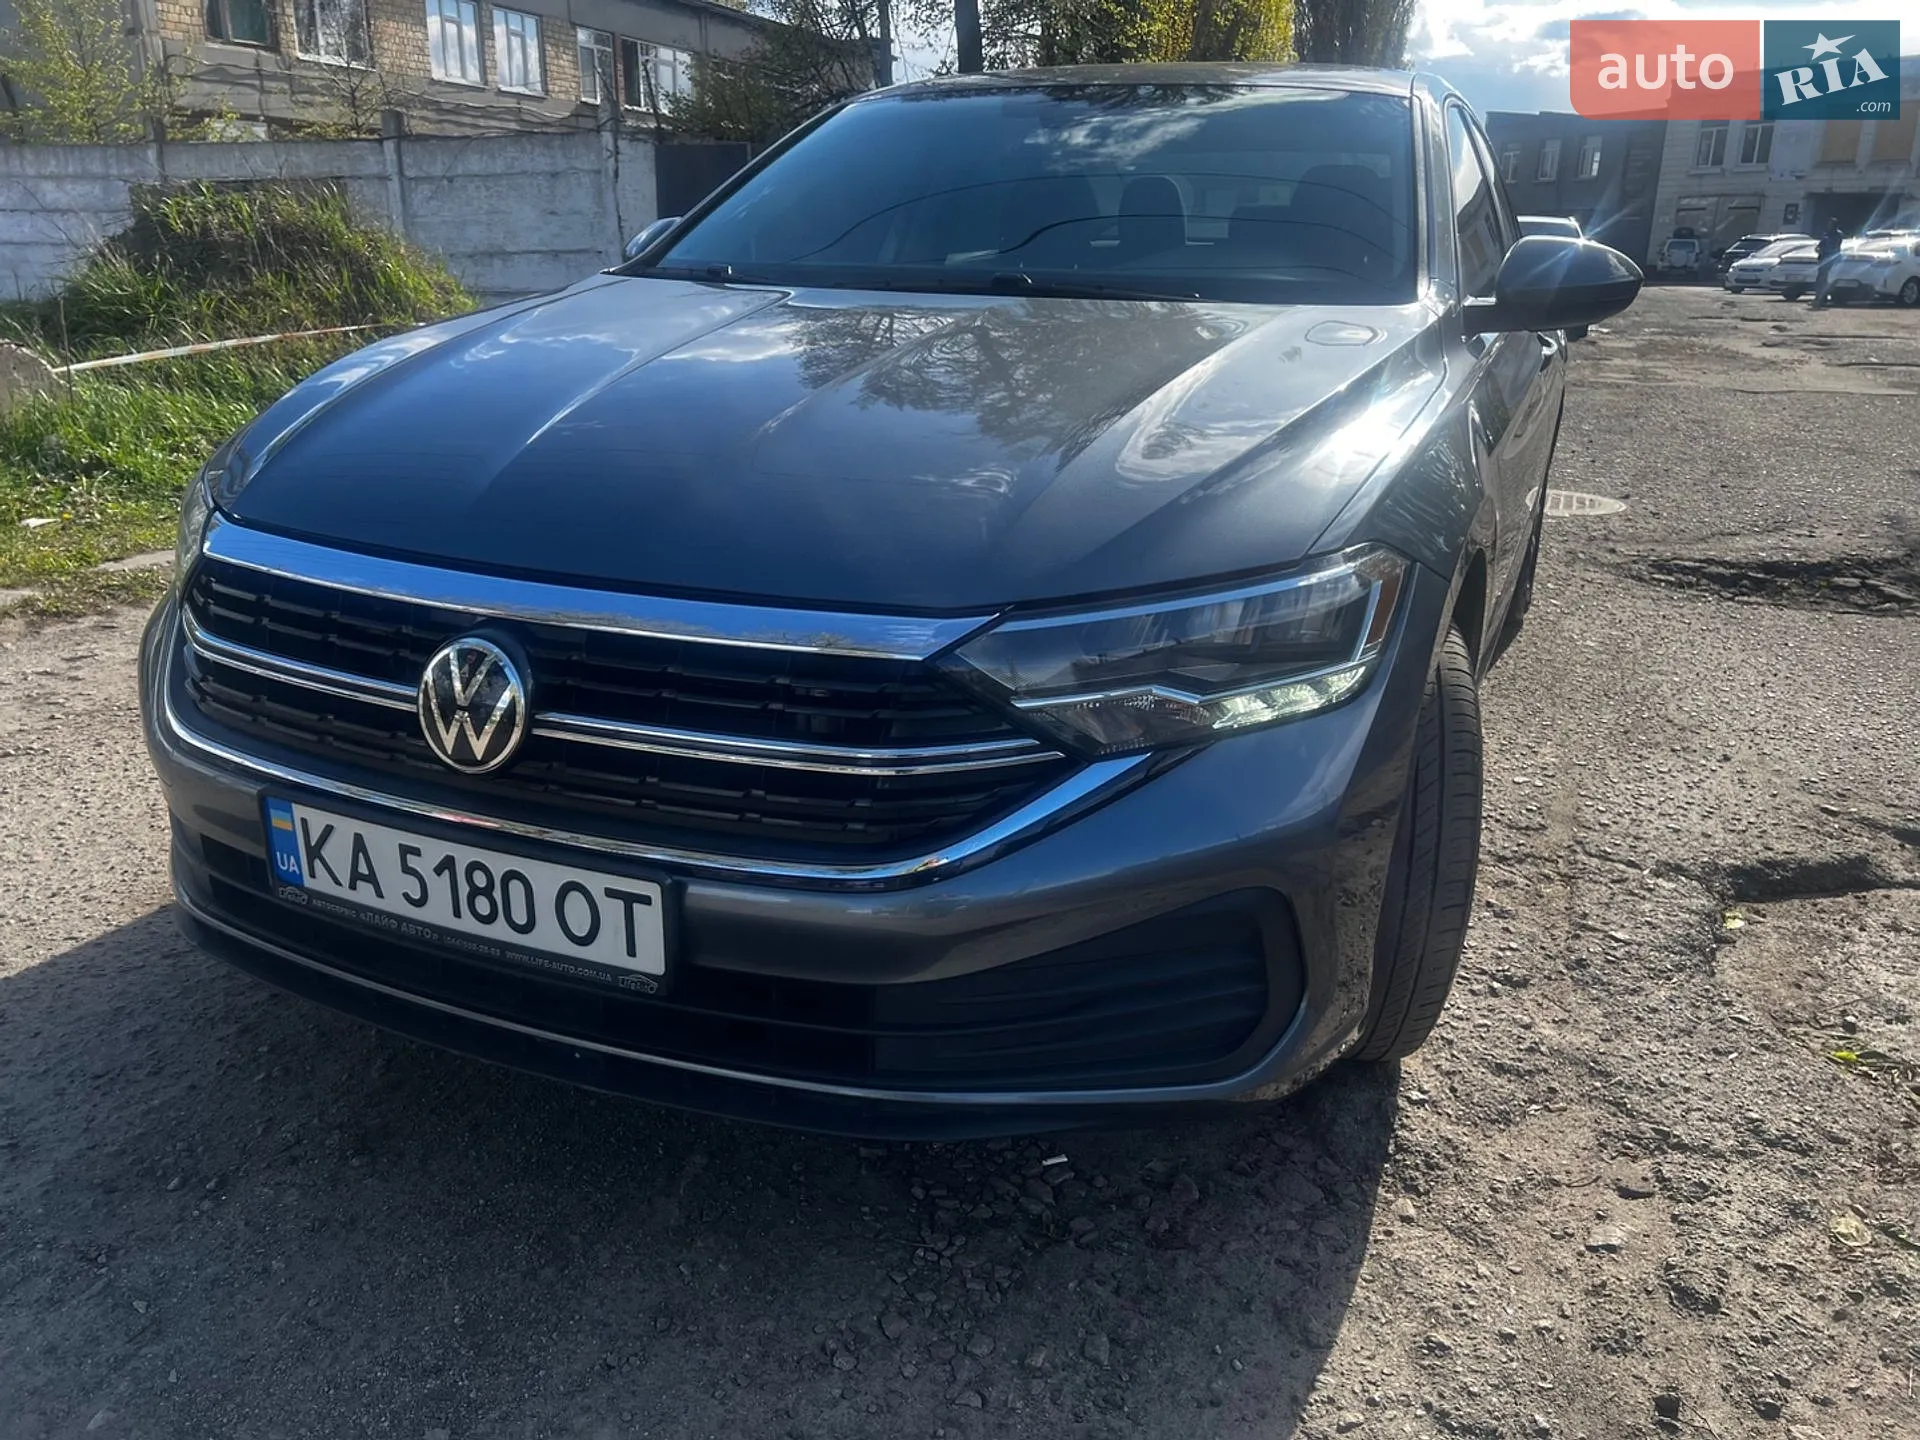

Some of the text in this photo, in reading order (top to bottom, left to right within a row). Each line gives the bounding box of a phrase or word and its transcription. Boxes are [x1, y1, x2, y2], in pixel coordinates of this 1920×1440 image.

[276, 850, 300, 875] UA
[300, 817, 653, 958] KA 5180 OT
